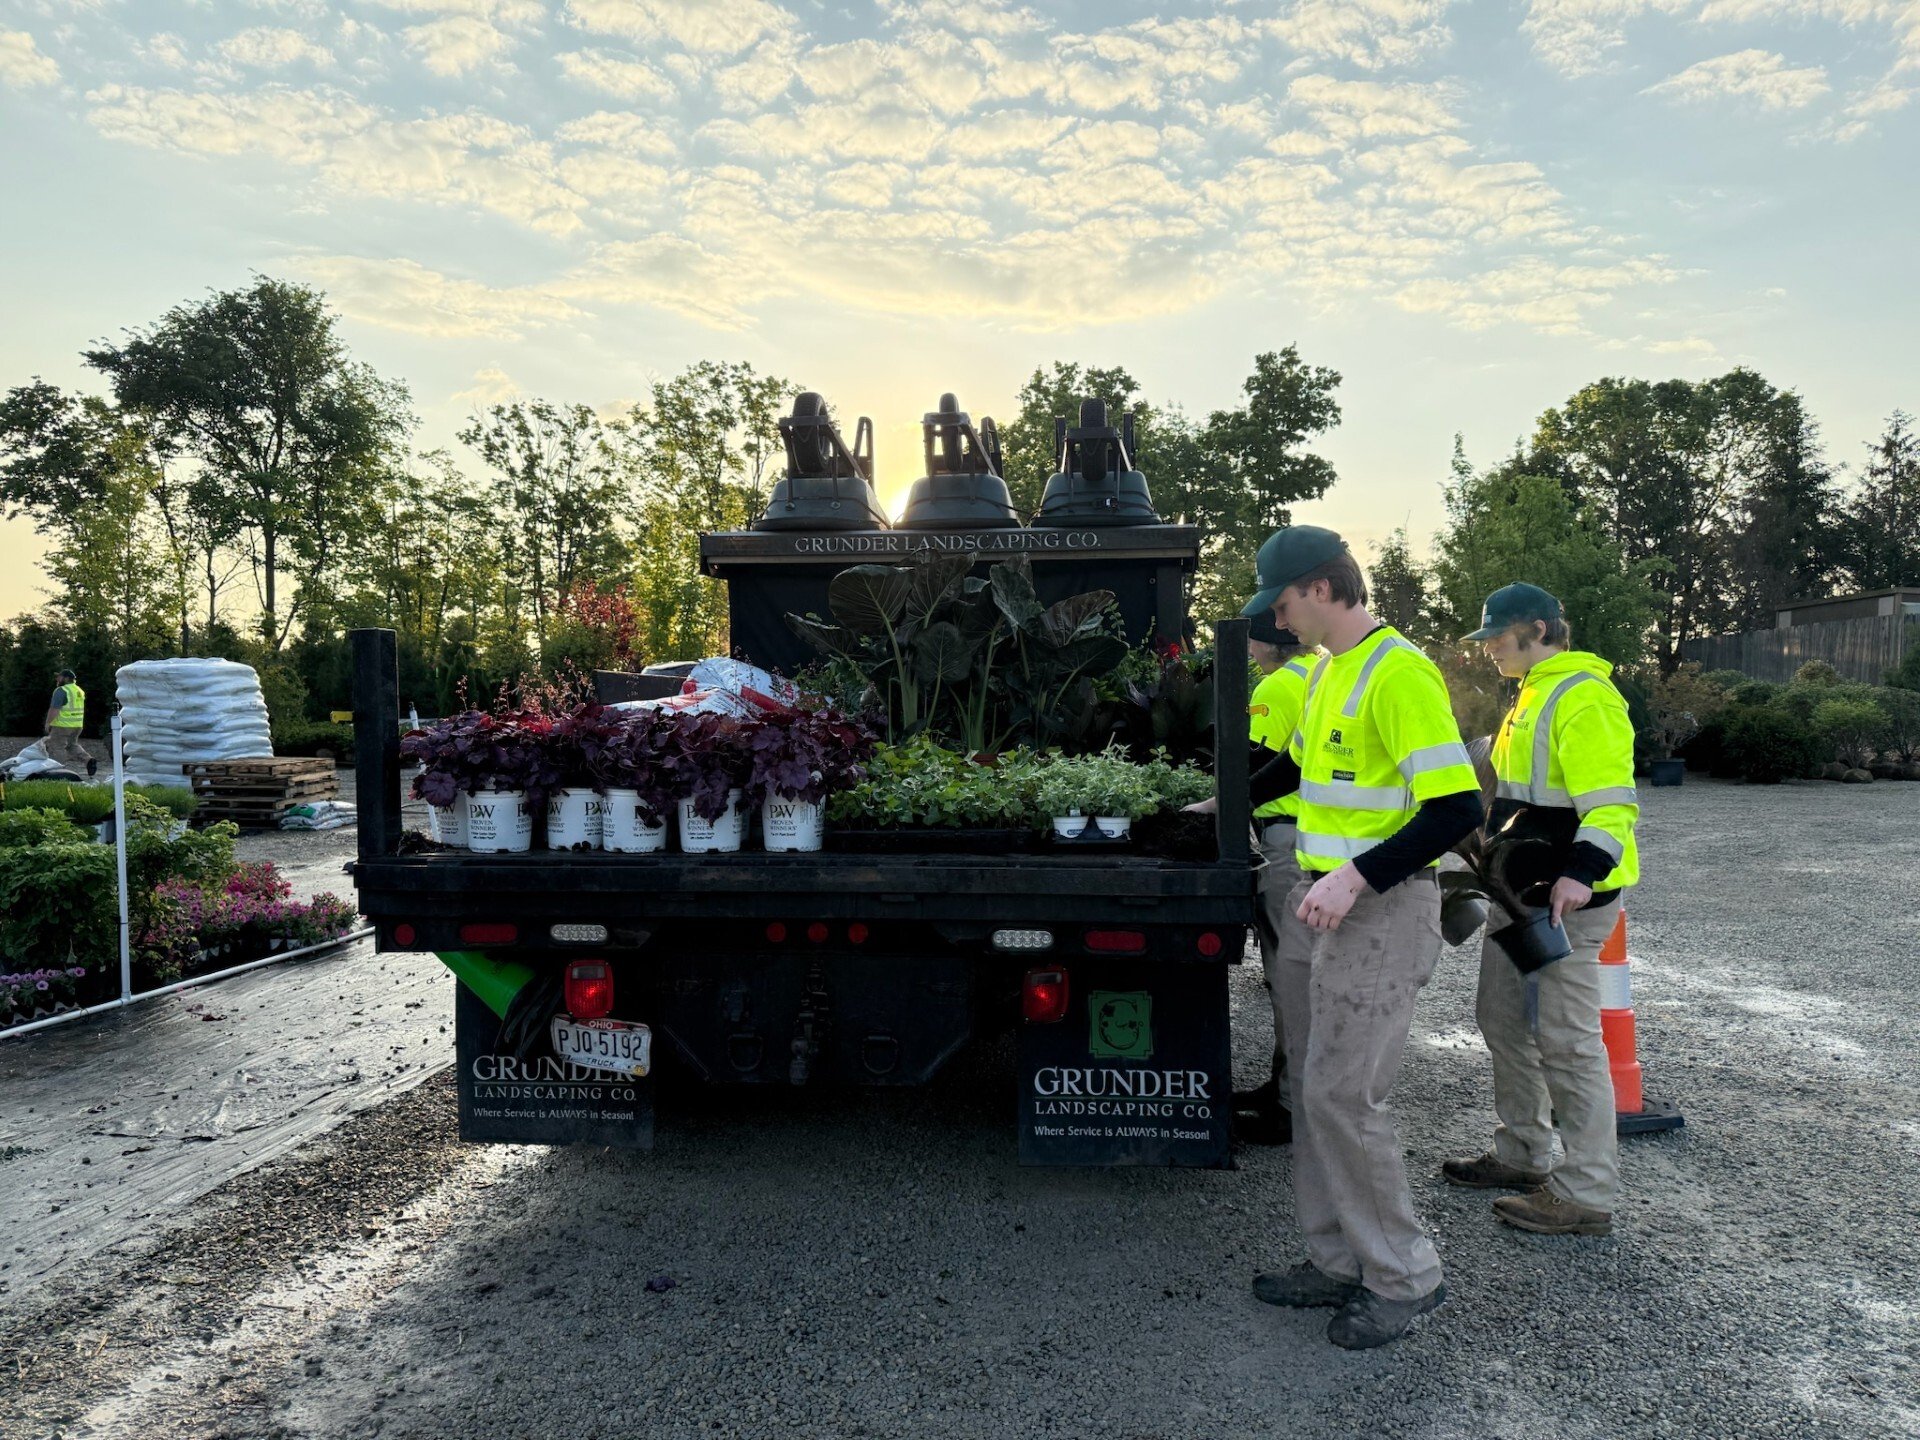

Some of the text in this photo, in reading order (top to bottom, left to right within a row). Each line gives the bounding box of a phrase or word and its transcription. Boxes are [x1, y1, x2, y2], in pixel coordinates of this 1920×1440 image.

[795, 532, 1102, 553] GRUNDER LANDSCAPING CO.
[588, 1020, 613, 1029] OHIO
[558, 1029, 641, 1061] PJQ 5192
[587, 1057, 615, 1067] TRUCK
[1034, 1066, 1211, 1099] GRUNDER
[474, 1086, 637, 1101] LANDSCAPING CO.
[473, 1108, 634, 1121] Where Service is ALWAYS in Season!
[1035, 1101, 1213, 1119] LANDSCAPING CO.
[1034, 1126, 1210, 1141] Where Service is ALWAYS in Season!
